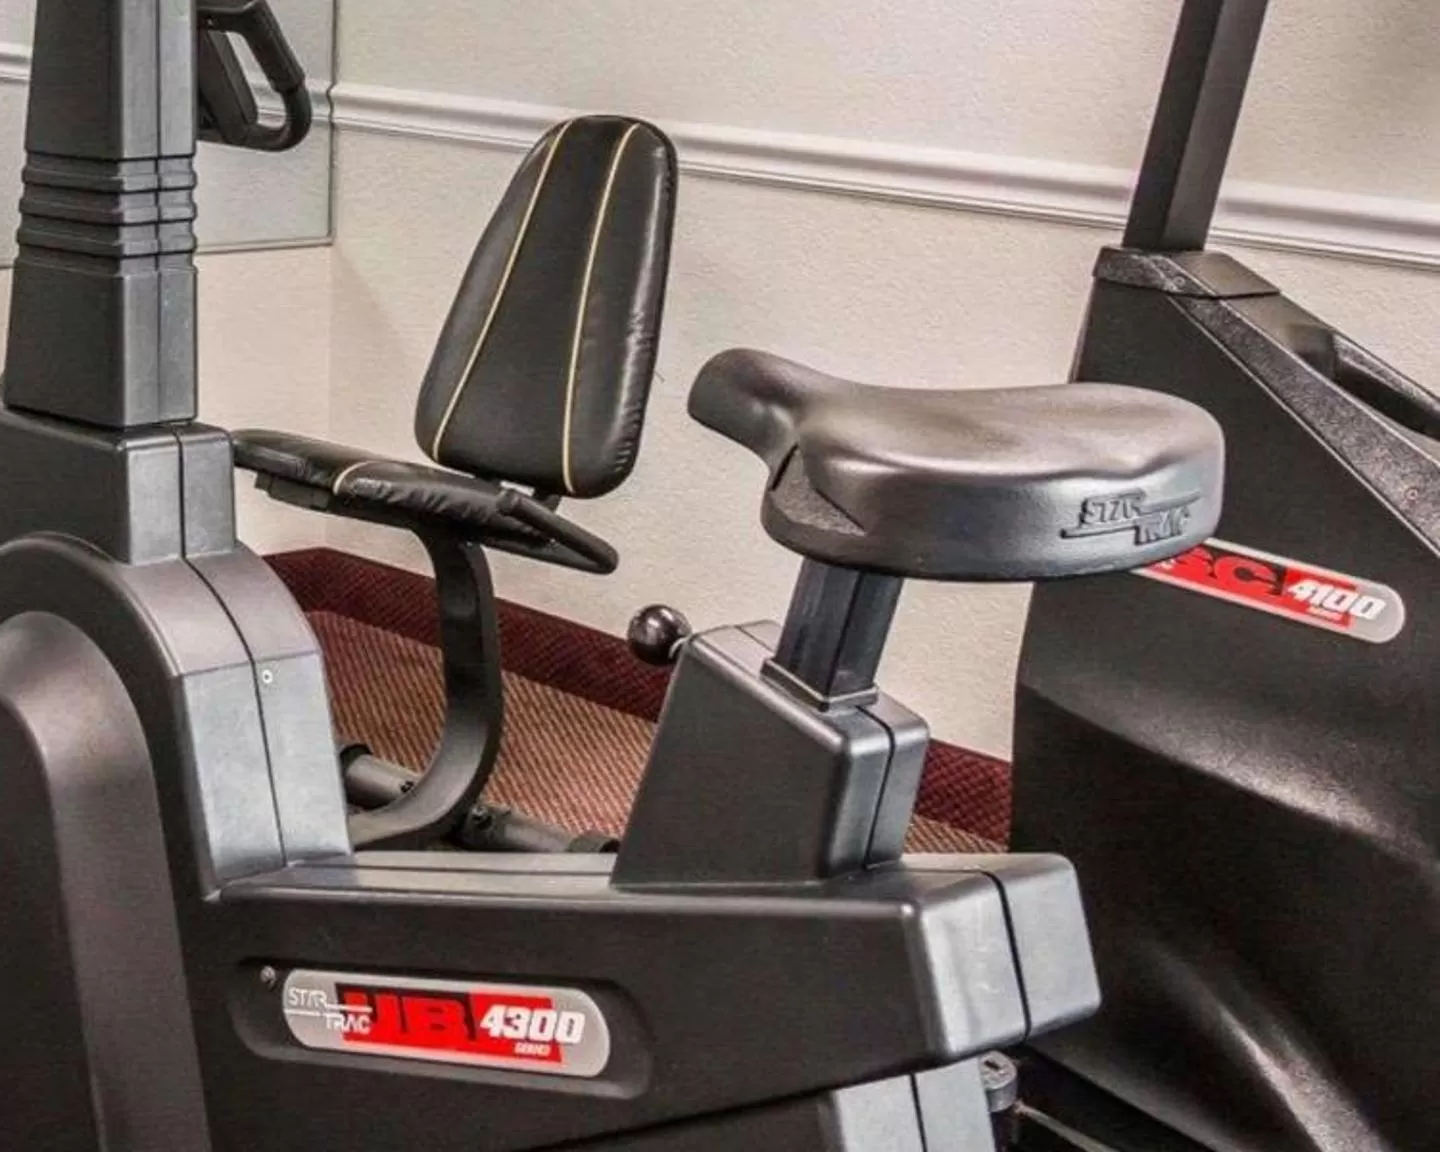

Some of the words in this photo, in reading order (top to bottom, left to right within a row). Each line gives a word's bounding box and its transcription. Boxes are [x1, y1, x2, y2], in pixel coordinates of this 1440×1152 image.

[1286, 579, 1388, 621] 4100
[288, 987, 328, 1009] STAR
[321, 1011, 371, 1035] TRAC
[480, 1004, 586, 1044] 4300
